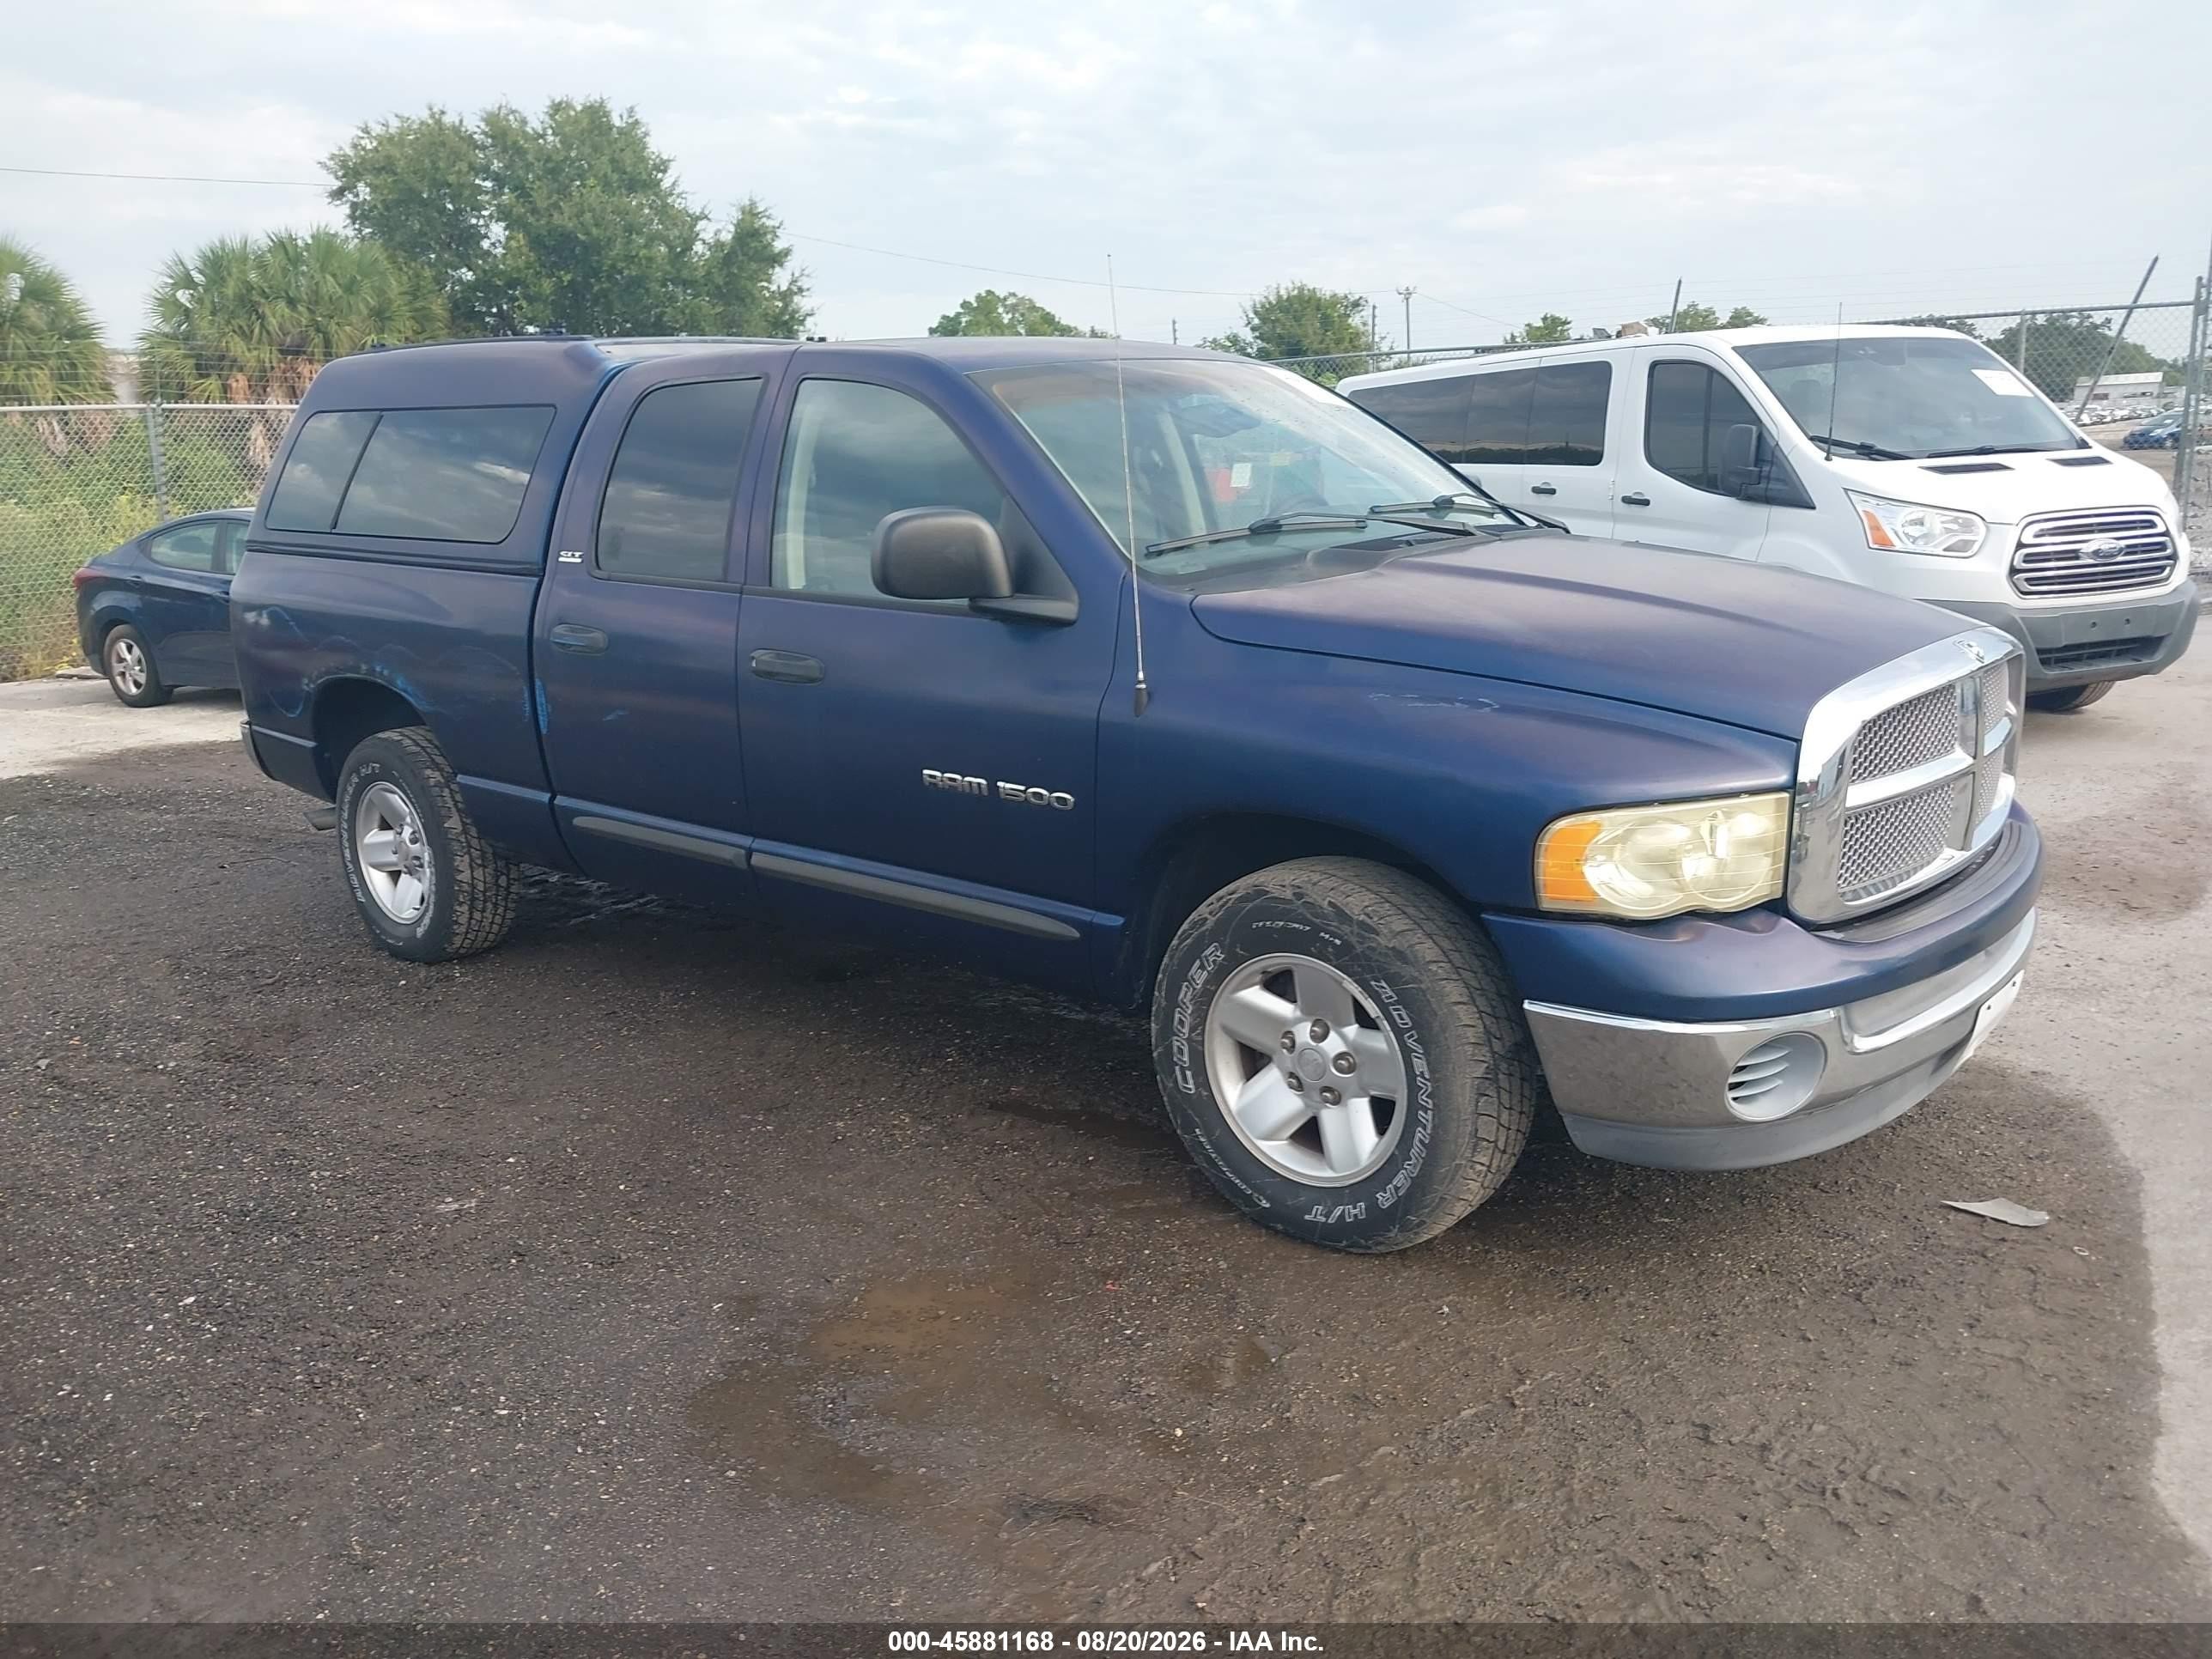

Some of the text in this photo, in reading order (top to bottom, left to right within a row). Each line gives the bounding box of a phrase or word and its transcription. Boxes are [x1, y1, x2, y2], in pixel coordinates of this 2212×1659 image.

[922, 769, 1074, 811] RAM 1500
[1171, 942, 1225, 1094] COOPER
[1304, 979, 1435, 1224] ADVENTURER H/T
